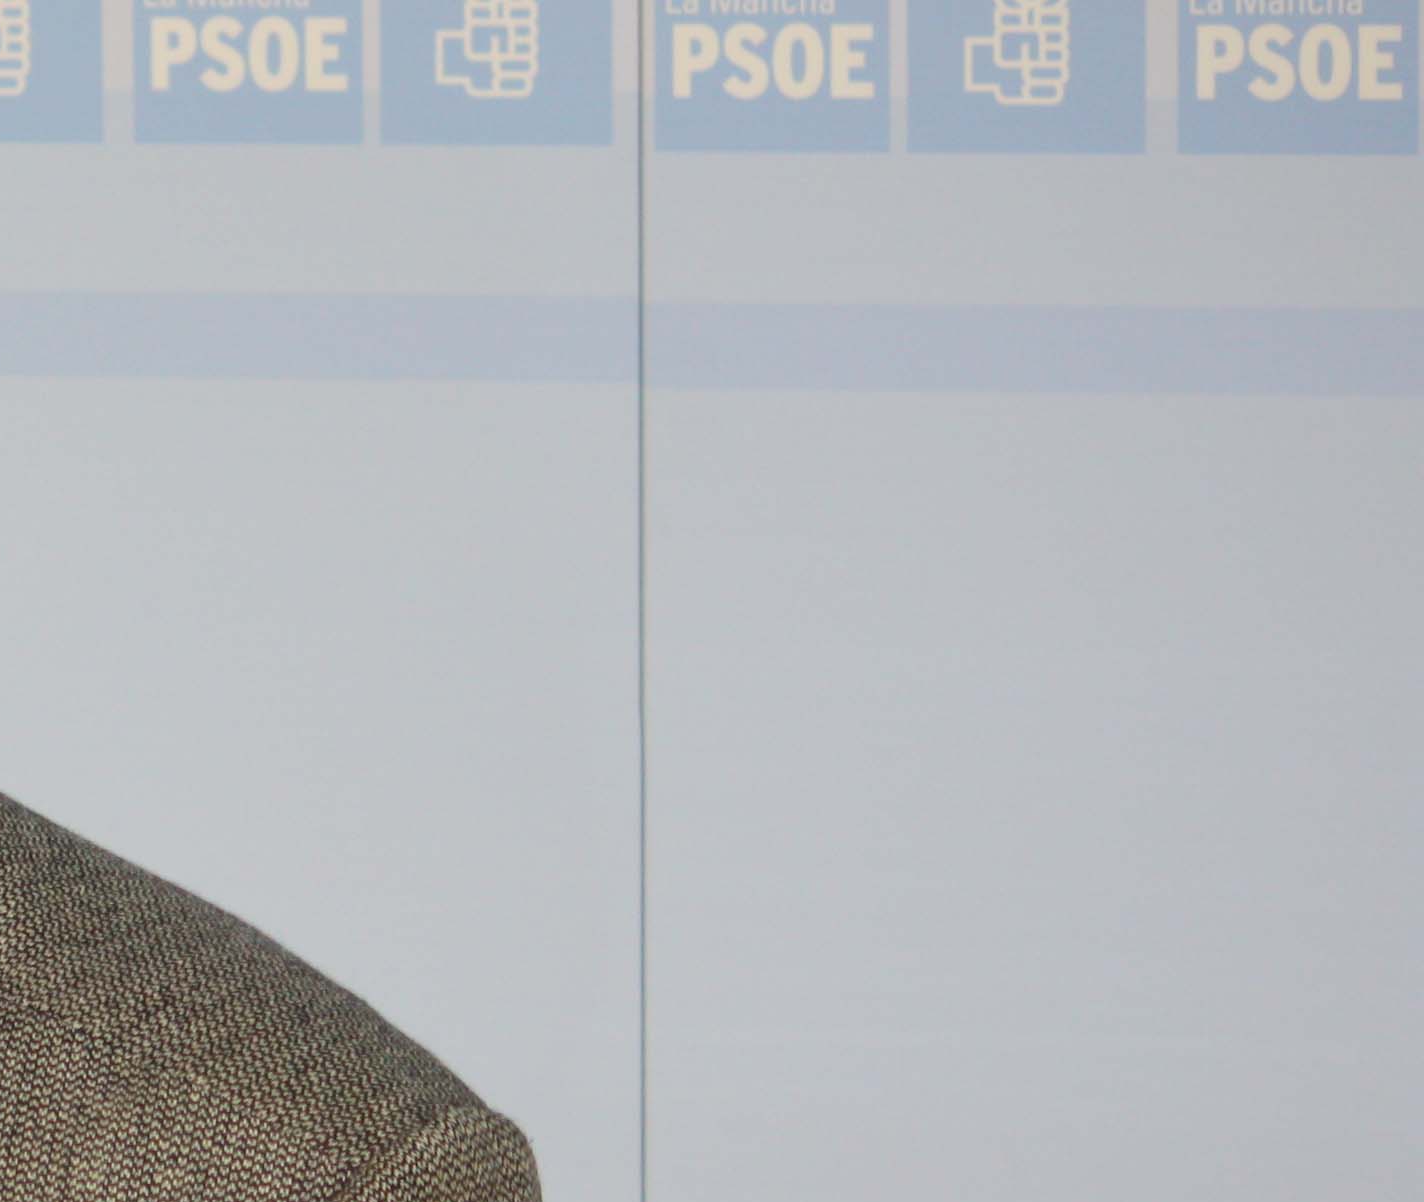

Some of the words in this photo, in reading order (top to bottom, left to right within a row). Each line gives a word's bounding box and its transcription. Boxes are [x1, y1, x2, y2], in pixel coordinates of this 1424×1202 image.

[152, 17, 347, 91] PSOE
[673, 23, 874, 99] PSOE
[1197, 24, 1403, 100] PSOE
